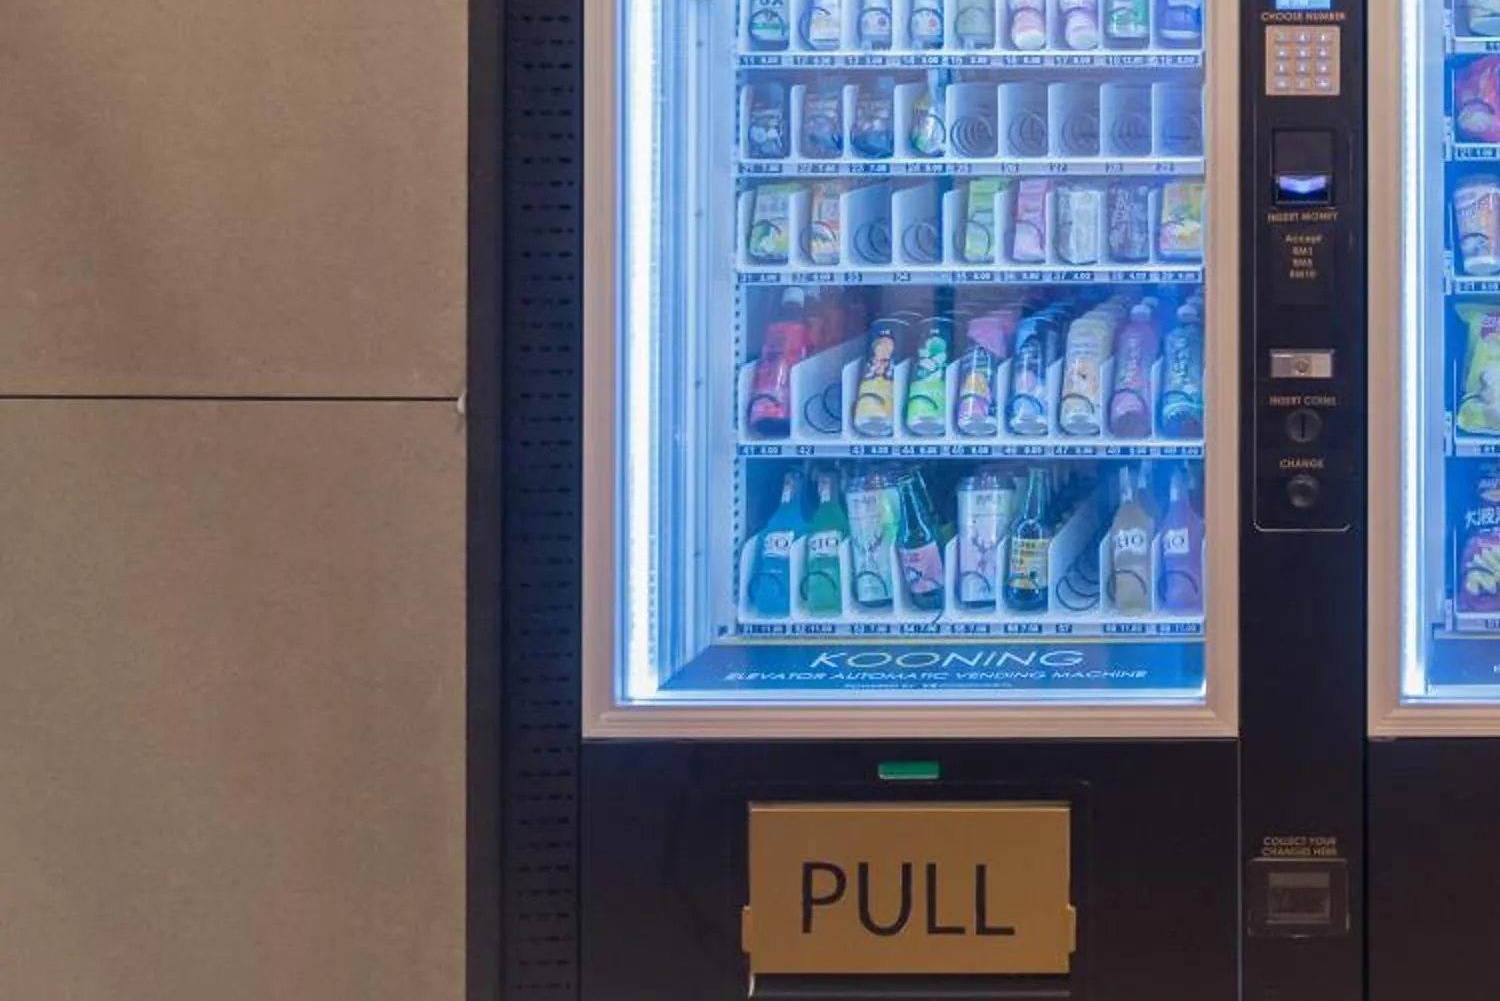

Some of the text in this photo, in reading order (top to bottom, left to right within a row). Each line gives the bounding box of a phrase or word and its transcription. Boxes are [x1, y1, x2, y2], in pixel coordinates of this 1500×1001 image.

[1280, 459, 1324, 469] CHANGE
[809, 651, 1084, 668] KOONING
[725, 670, 1148, 680] ELEVATOR AUTOMATIC VENDING MACHINE
[801, 861, 1015, 937] PULL
